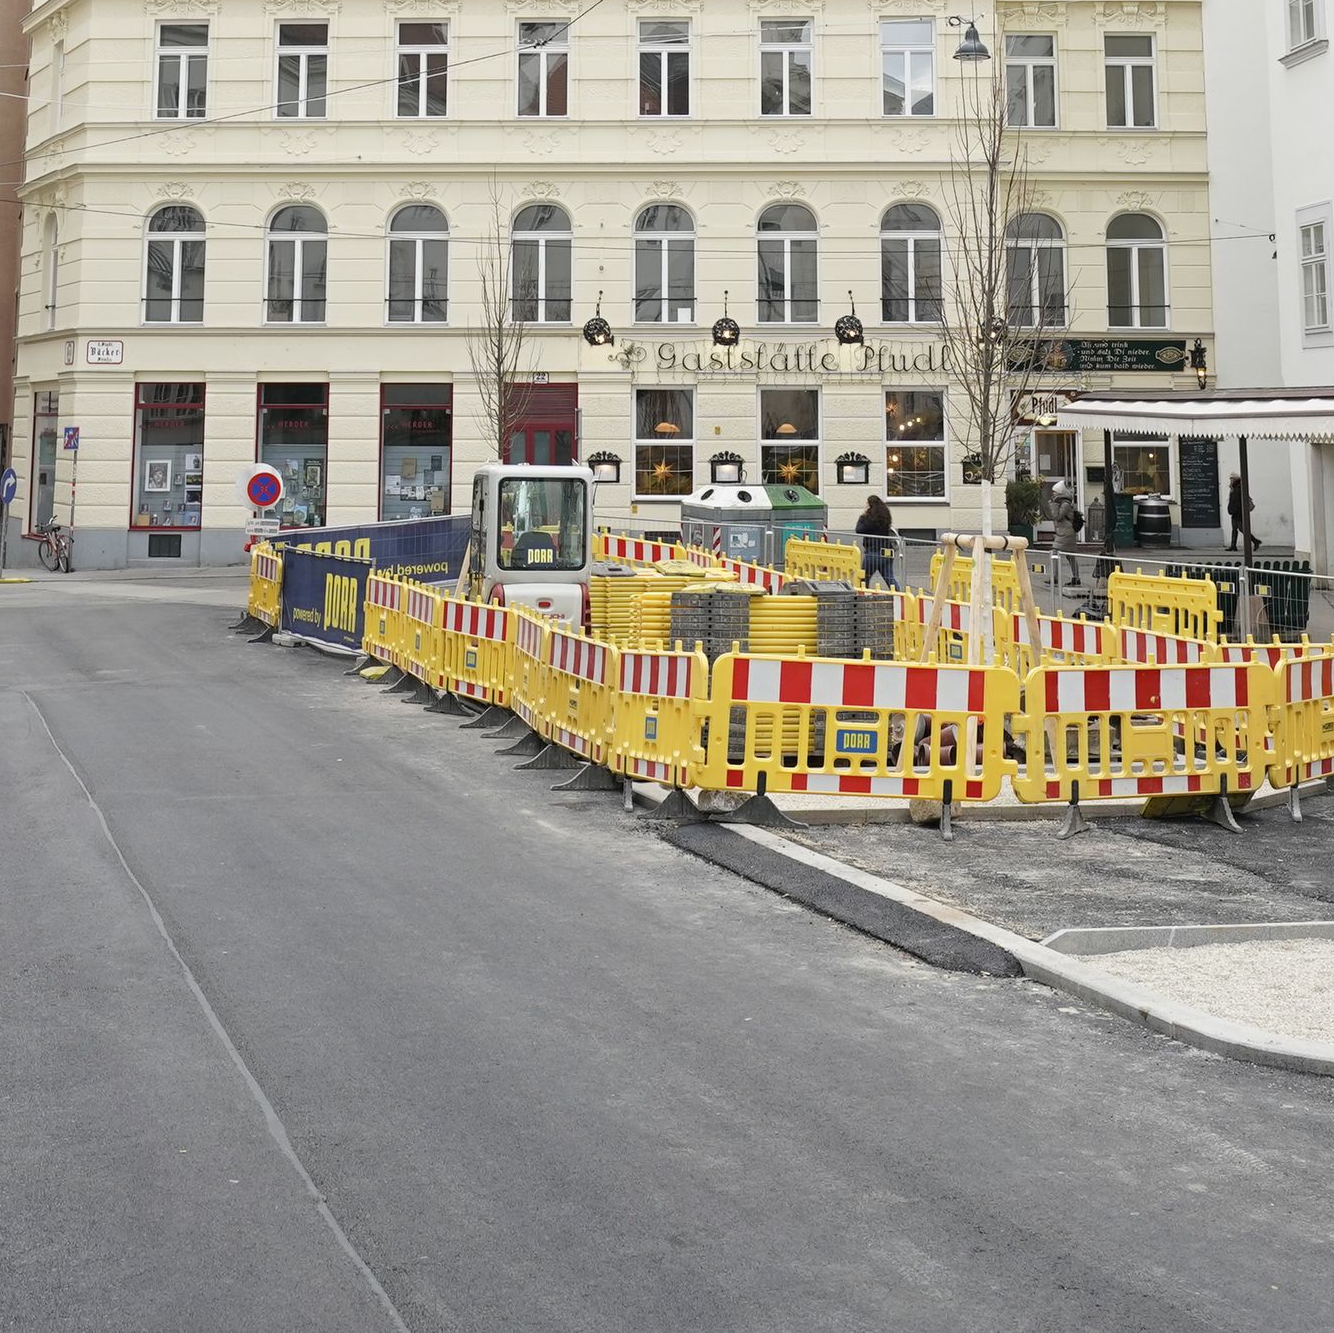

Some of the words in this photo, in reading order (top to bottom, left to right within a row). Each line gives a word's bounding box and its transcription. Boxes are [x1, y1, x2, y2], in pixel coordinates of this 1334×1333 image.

[657, 342, 840, 372] Gaststätte
[856, 344, 955, 372] Pfudl
[527, 548, 554, 565] PORR
[323, 572, 358, 634] PORR
[292, 607, 314, 623] powered
[314, 608, 322, 628] by
[843, 732, 871, 750] PORR
